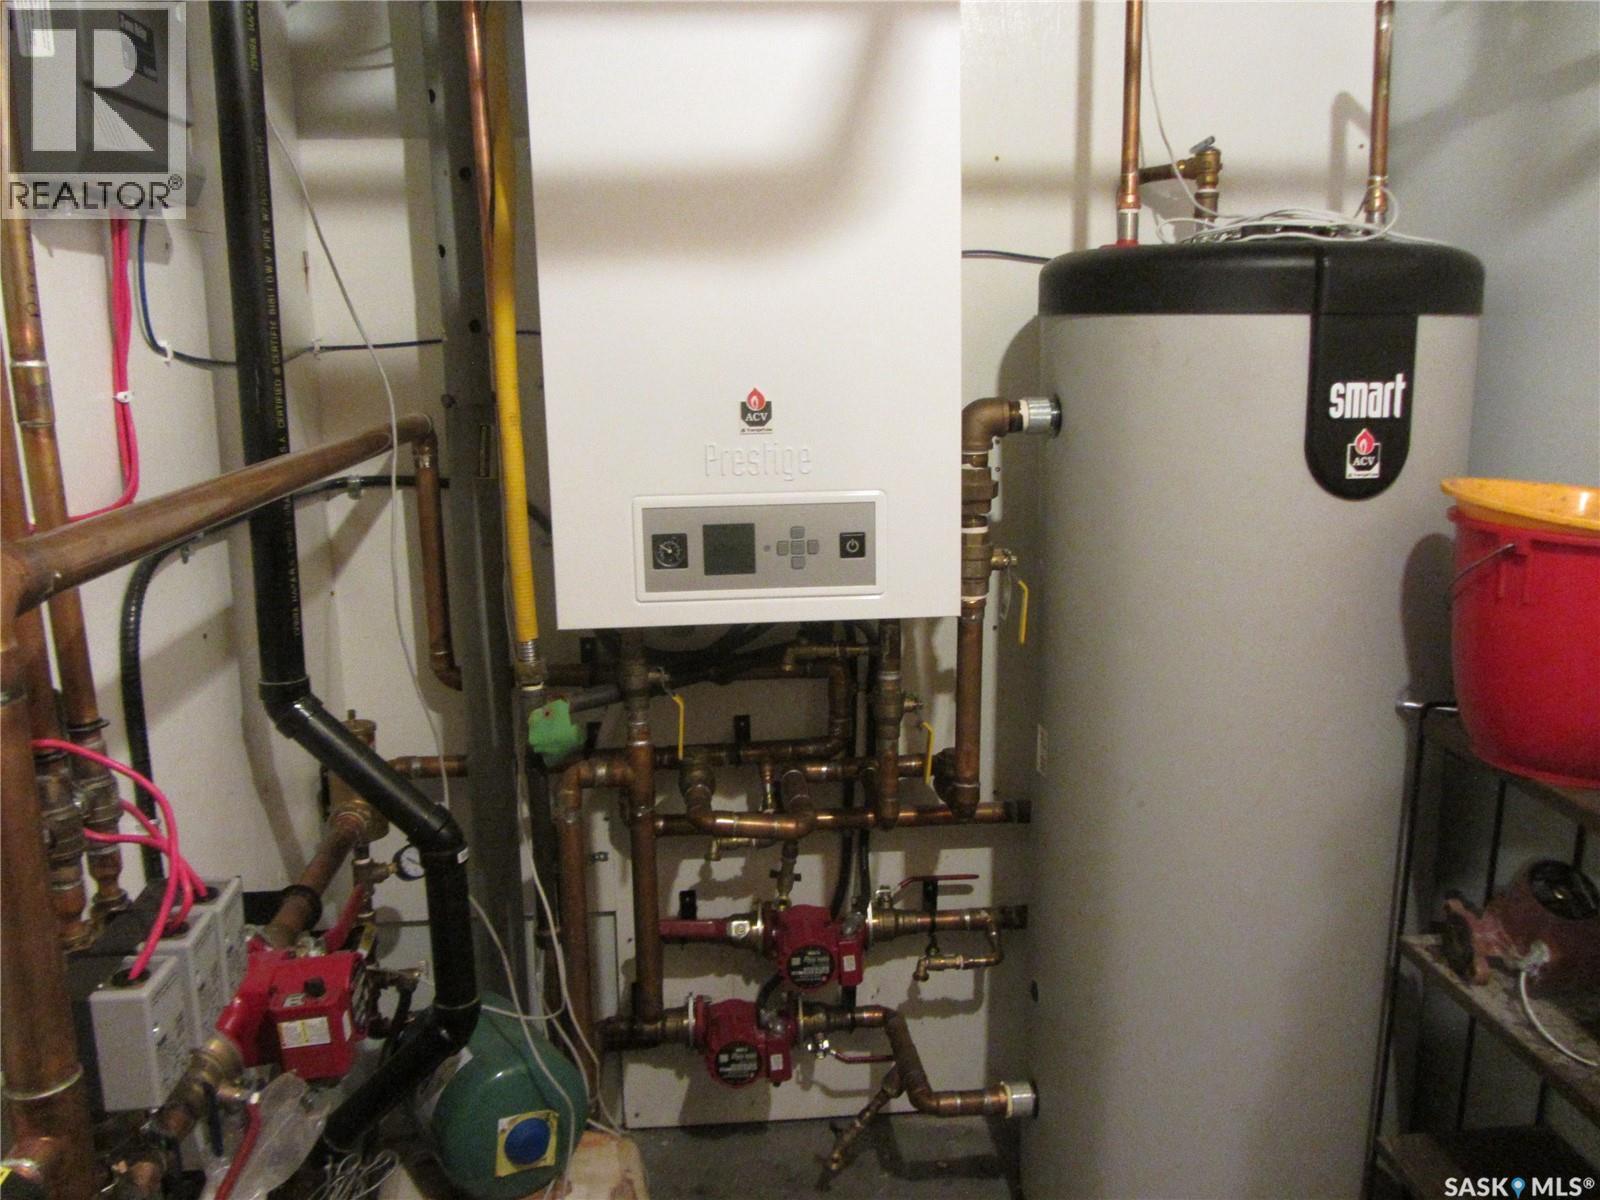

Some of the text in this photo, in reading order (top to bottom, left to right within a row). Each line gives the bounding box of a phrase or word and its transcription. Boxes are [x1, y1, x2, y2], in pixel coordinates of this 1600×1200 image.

[1328, 373, 1407, 419] smart
[745, 412, 769, 422] ACV
[704, 441, 813, 482] Prestige
[1352, 456, 1376, 467] ACV
